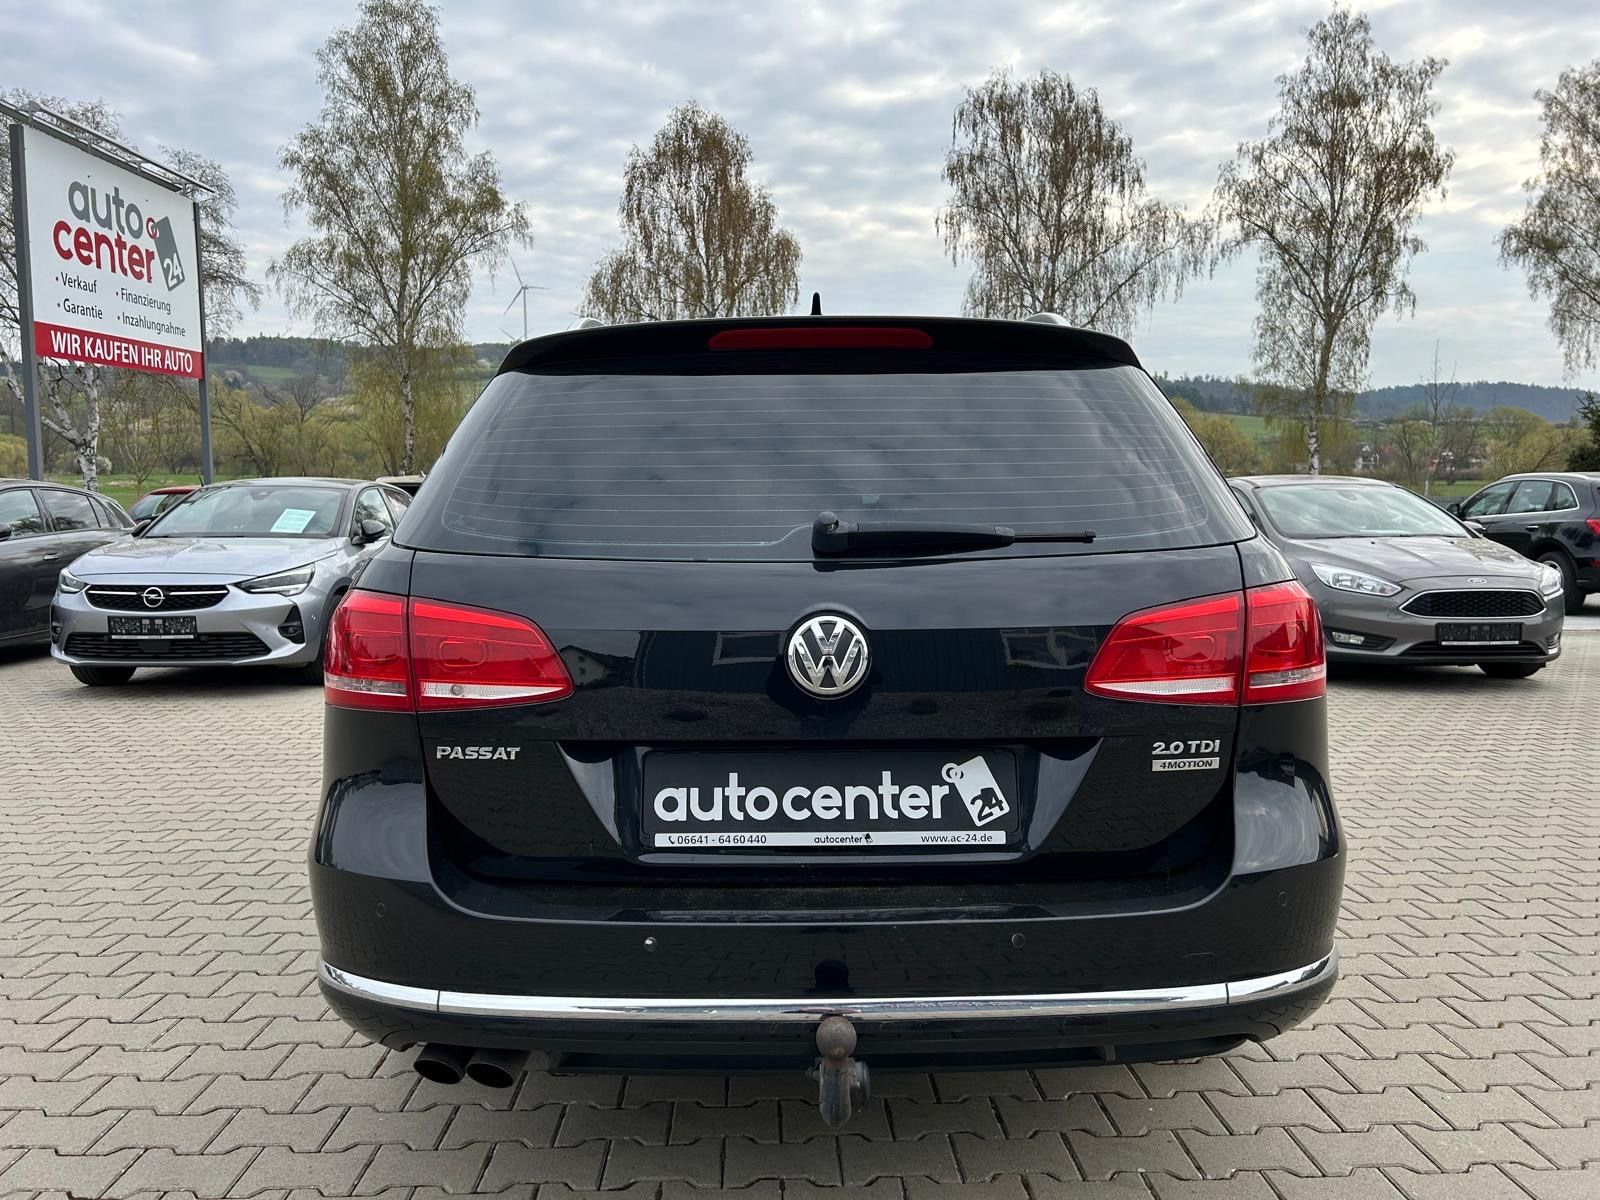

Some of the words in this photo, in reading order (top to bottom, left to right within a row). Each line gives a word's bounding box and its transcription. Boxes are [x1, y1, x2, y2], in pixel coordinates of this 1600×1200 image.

[68, 181, 144, 240] auto
[53, 220, 155, 283] center
[163, 252, 184, 286] 24
[61, 272, 97, 294] Verkauf
[63, 299, 103, 320] Garantie
[121, 288, 171, 315] Finanzierung
[122, 315, 186, 337] Inzahlungnahme
[50, 330, 81, 356] WIR
[84, 336, 139, 366] KAUFEN
[141, 347, 162, 369] IHR
[164, 351, 193, 373] AUTO
[436, 746, 521, 760] PASSAT
[1152, 741, 1184, 755] 2.0
[1186, 740, 1221, 754] TDI
[1160, 760, 1213, 770] 4MOTION
[653, 771, 949, 821] autocenter
[969, 787, 1005, 822] 24
[677, 835, 708, 845] 06641
[813, 834, 862, 844] autocenter
[921, 833, 993, 844] www.ac-24.de
